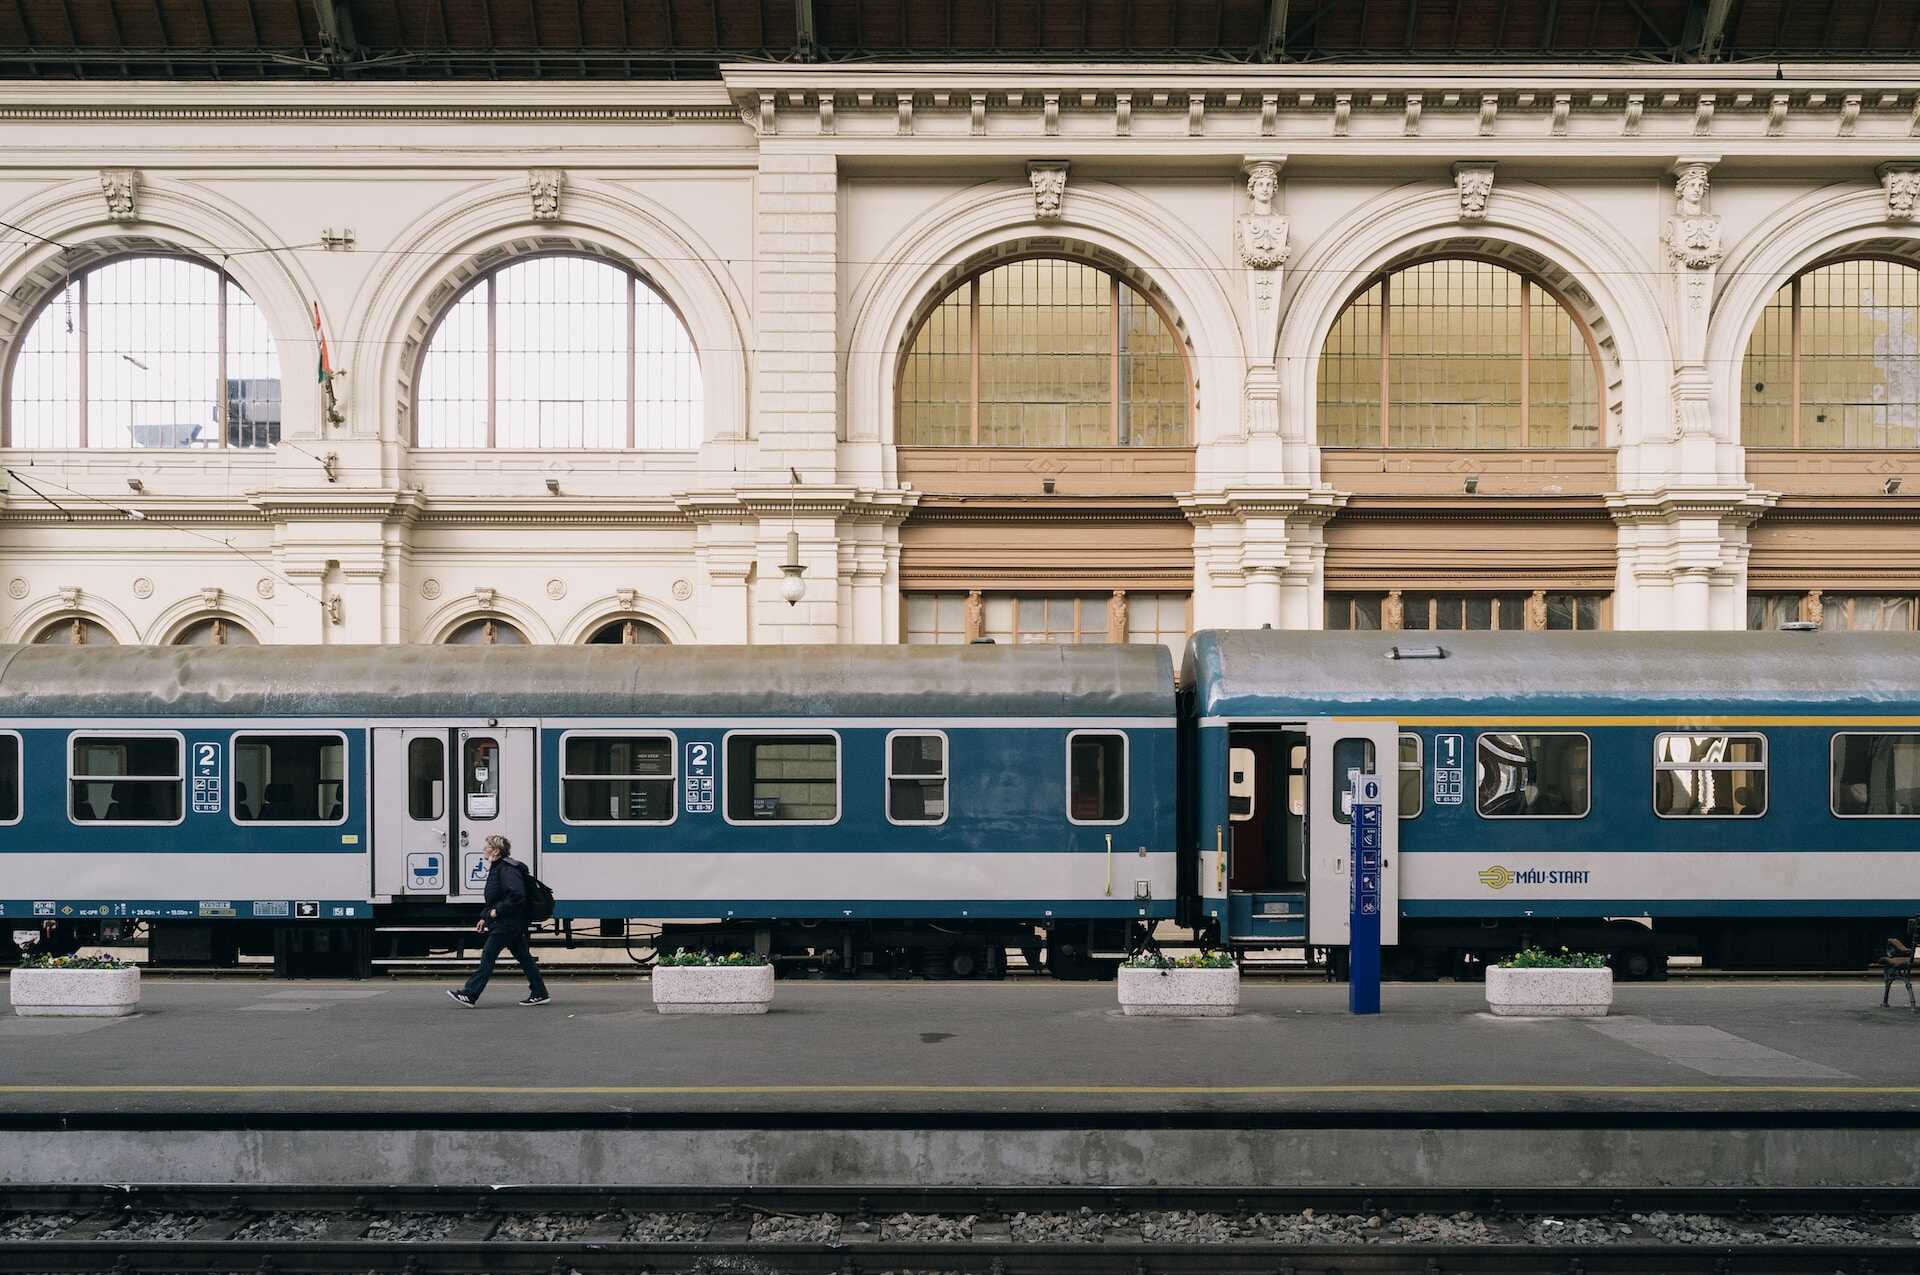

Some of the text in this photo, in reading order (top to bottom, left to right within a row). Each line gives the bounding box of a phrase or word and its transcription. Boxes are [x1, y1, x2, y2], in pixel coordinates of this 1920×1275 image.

[199, 745, 215, 766] 2
[692, 744, 708, 766] 2
[1444, 737, 1455, 757] 1
